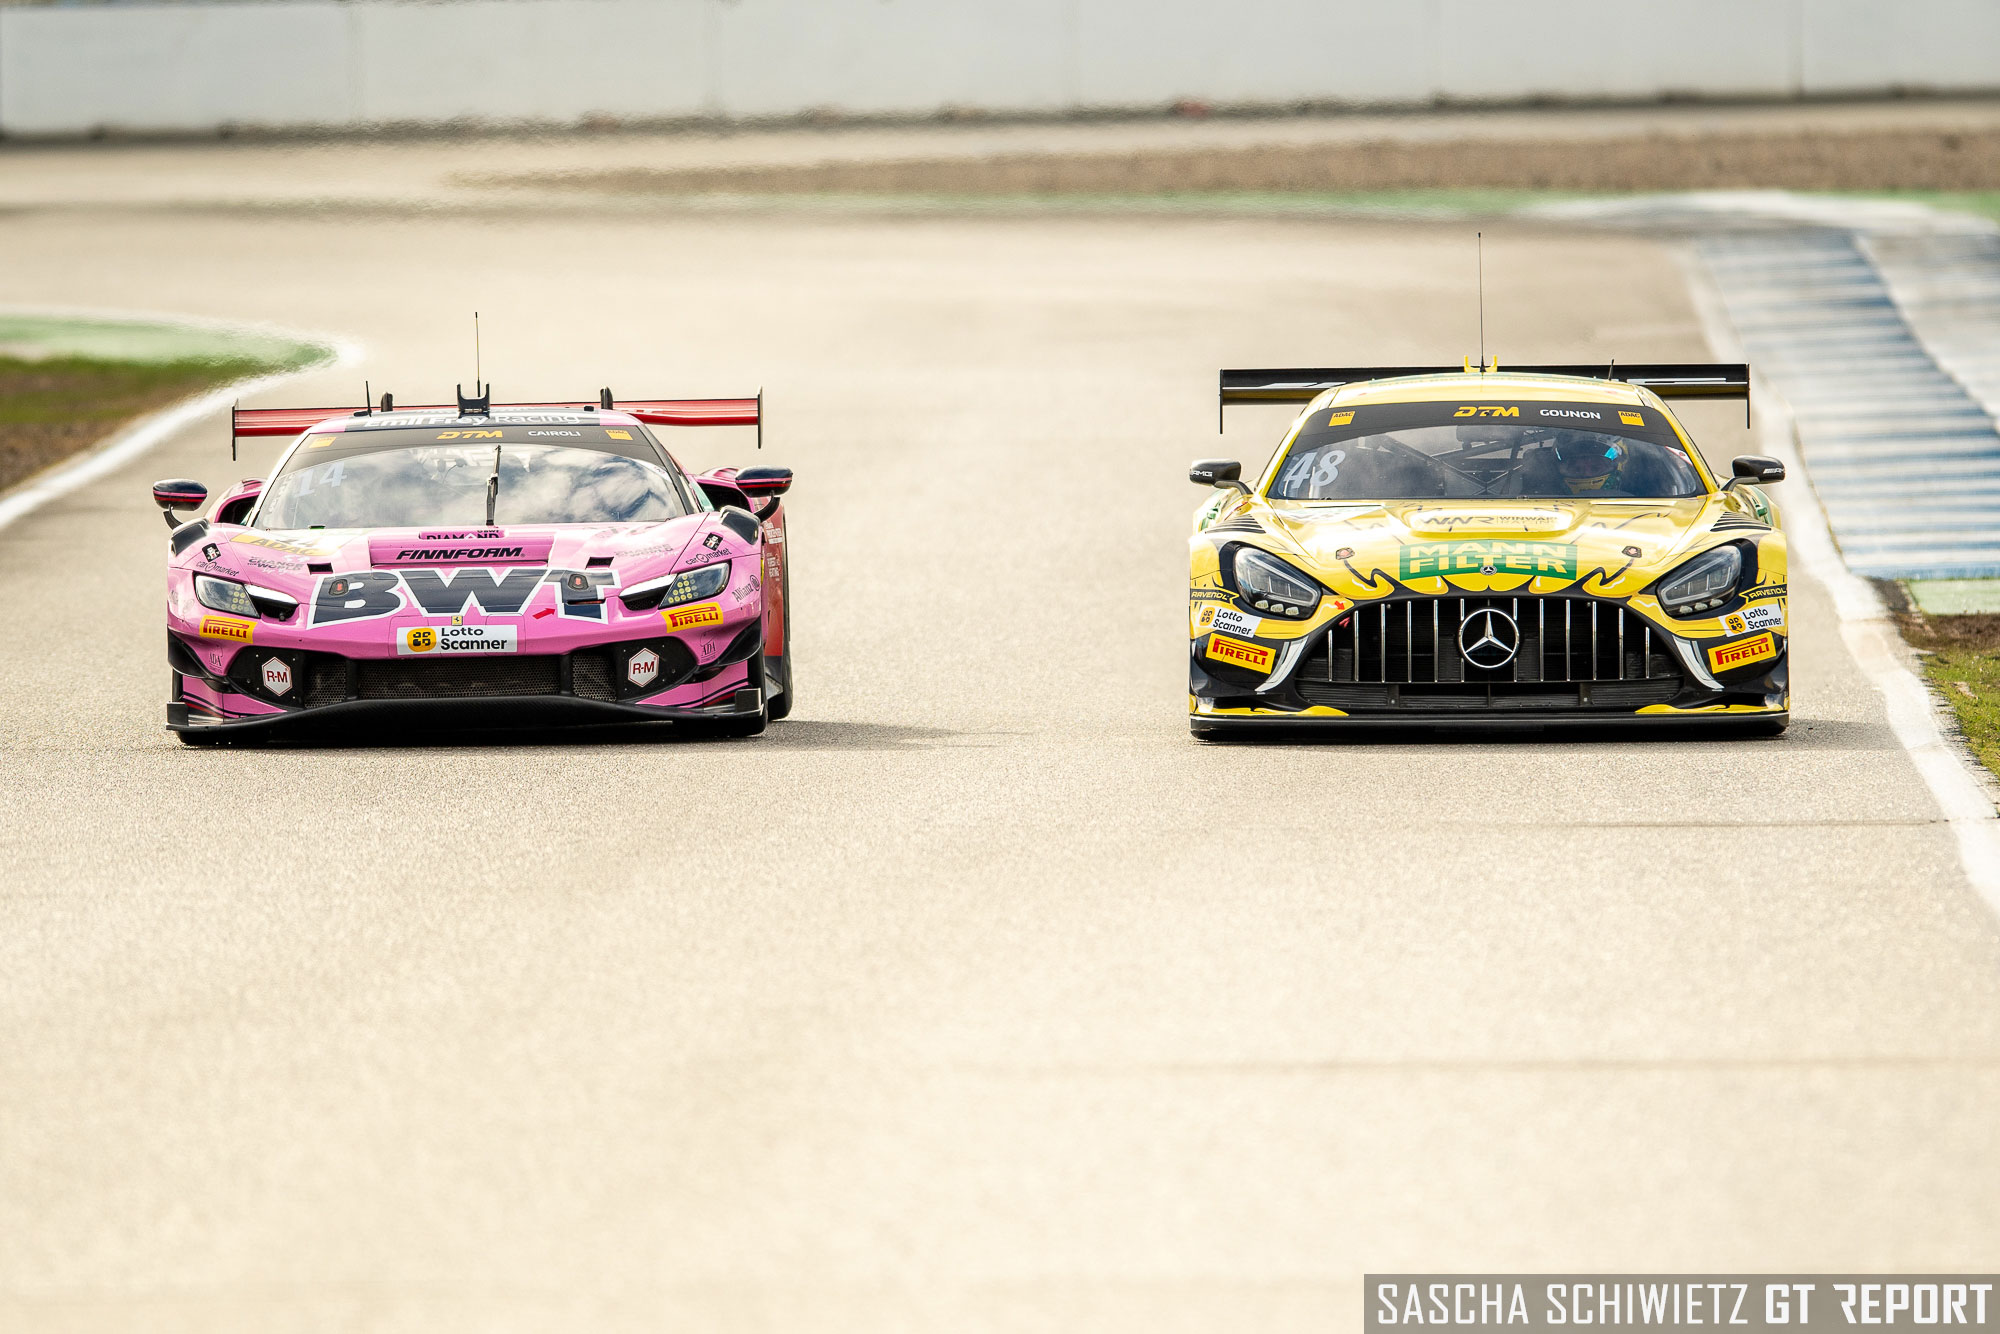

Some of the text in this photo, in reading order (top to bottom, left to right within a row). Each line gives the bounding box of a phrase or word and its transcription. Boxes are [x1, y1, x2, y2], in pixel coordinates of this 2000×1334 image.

[1453, 406, 1520, 417] DTM
[1540, 409, 1601, 419] GOUNON
[364, 416, 422, 427] Emil
[428, 415, 490, 425] Frey
[437, 430, 503, 439] DTM
[1283, 450, 1346, 488] 48
[293, 462, 348, 497] 14
[1410, 542, 1567, 558] MANN
[1410, 554, 1567, 574] FILTER
[306, 567, 621, 630] BWT
[732, 583, 754, 602] Allianz
[1191, 591, 1229, 600] RAVENOL
[1748, 587, 1787, 599] RAVENOL
[669, 606, 719, 627] PIRELLI
[1217, 608, 1243, 622] Lotto
[1742, 608, 1769, 620] Lotto
[203, 619, 250, 638] PIRELLI
[1212, 618, 1252, 635] Scanner
[1747, 617, 1782, 630] Scanner
[441, 627, 484, 636] Lotto
[440, 638, 507, 650] Scanner
[1715, 637, 1770, 665] PIRELLI
[1212, 638, 1268, 665] PIRELLI
[632, 661, 655, 675] R-M
[266, 670, 288, 683] R-M
